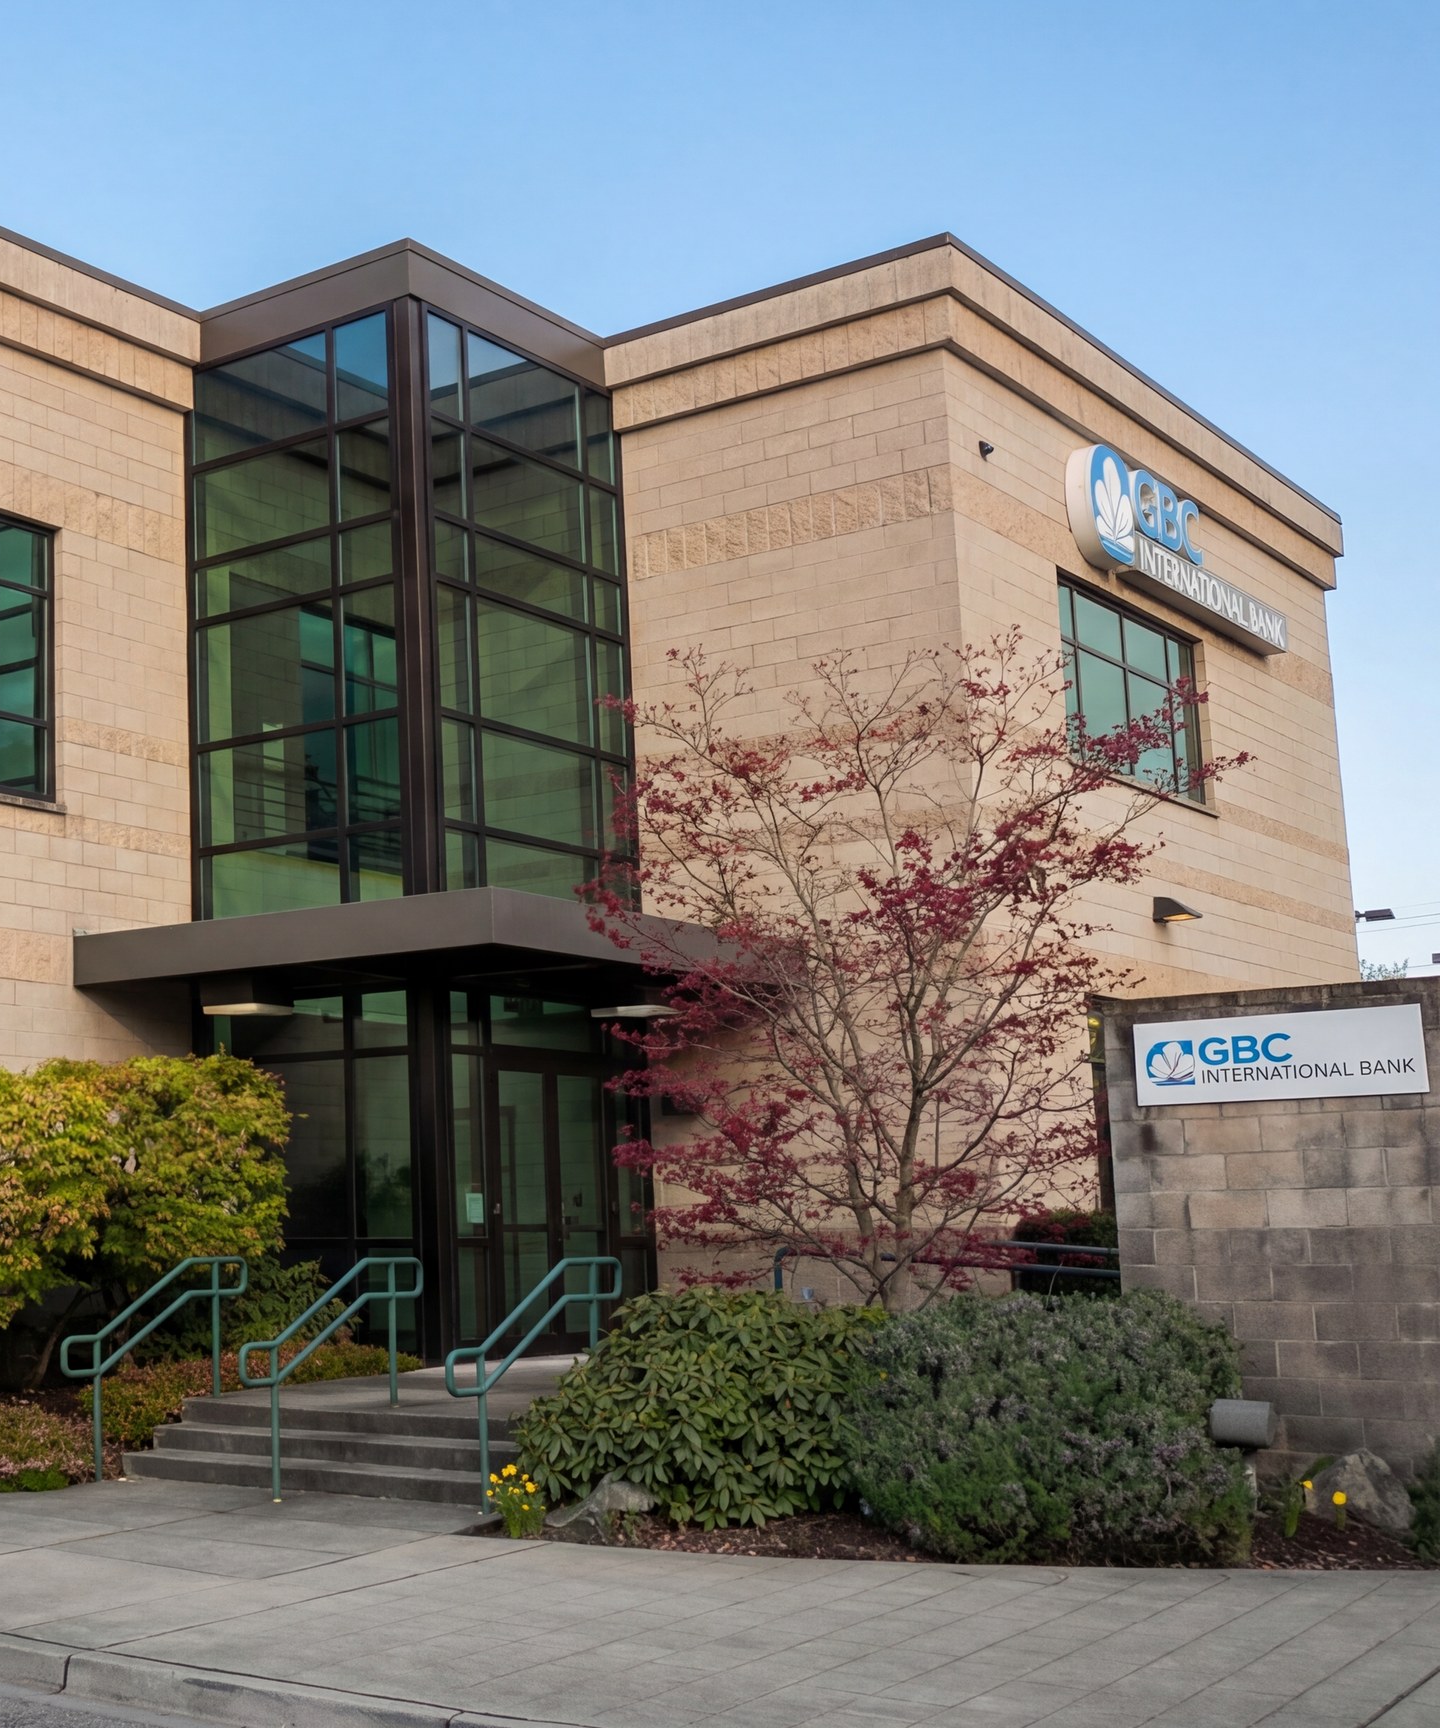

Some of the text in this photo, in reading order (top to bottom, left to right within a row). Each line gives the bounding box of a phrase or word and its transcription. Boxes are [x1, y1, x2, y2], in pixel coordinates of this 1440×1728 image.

[1133, 469, 1204, 566] GBC
[1139, 538, 1285, 648] INTERNATIONAL BANK
[1198, 1032, 1292, 1066] GBC
[1202, 1058, 1416, 1083] INTERNATIONAL BANK
